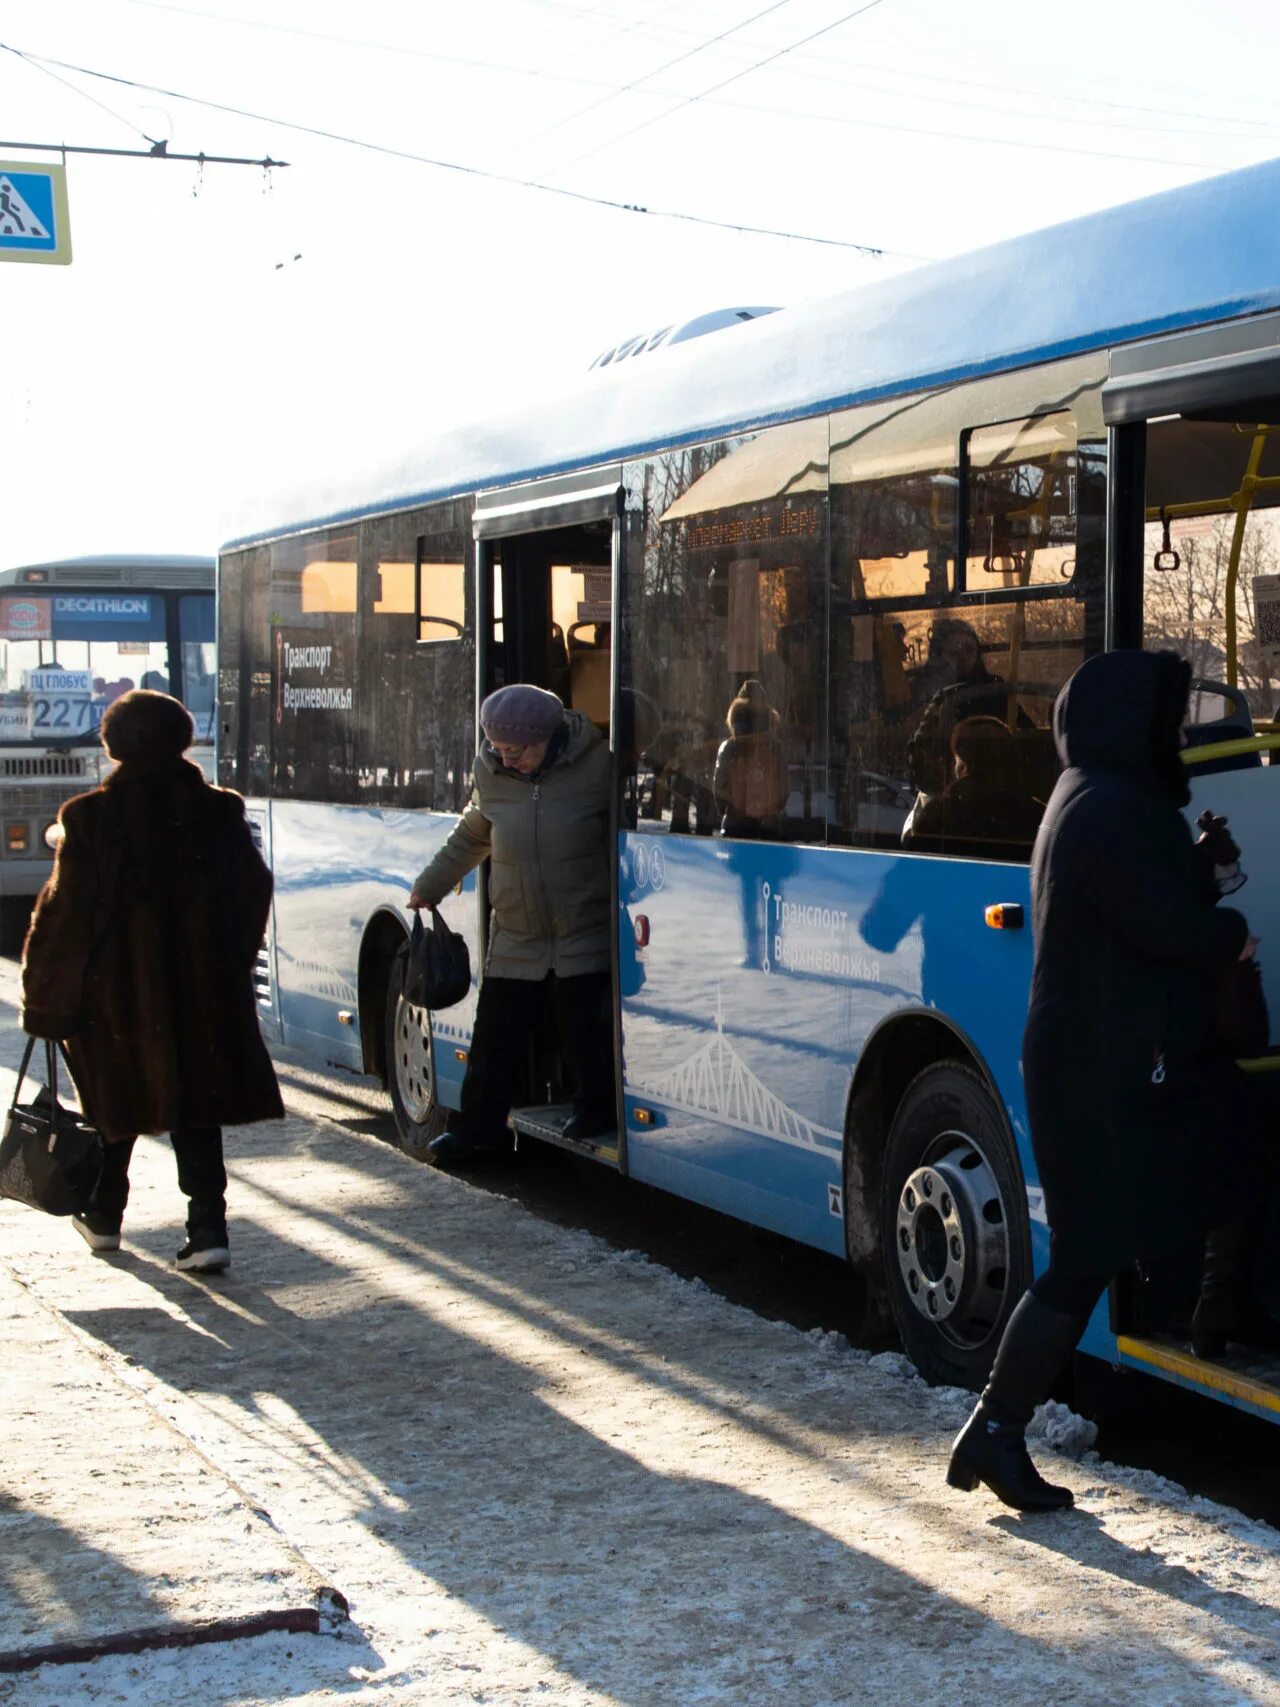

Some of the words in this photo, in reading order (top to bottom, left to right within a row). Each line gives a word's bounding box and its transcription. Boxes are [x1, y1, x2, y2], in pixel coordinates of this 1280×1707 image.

[55, 597, 149, 614] DECATHLON
[283, 642, 332, 677] Транспорт
[46, 673, 88, 690] ГЛОБУС
[283, 681, 353, 717] Верхневолжья
[33, 698, 89, 728] 227
[774, 895, 848, 937] Транспорт
[774, 935, 881, 983] Верхневолжья
